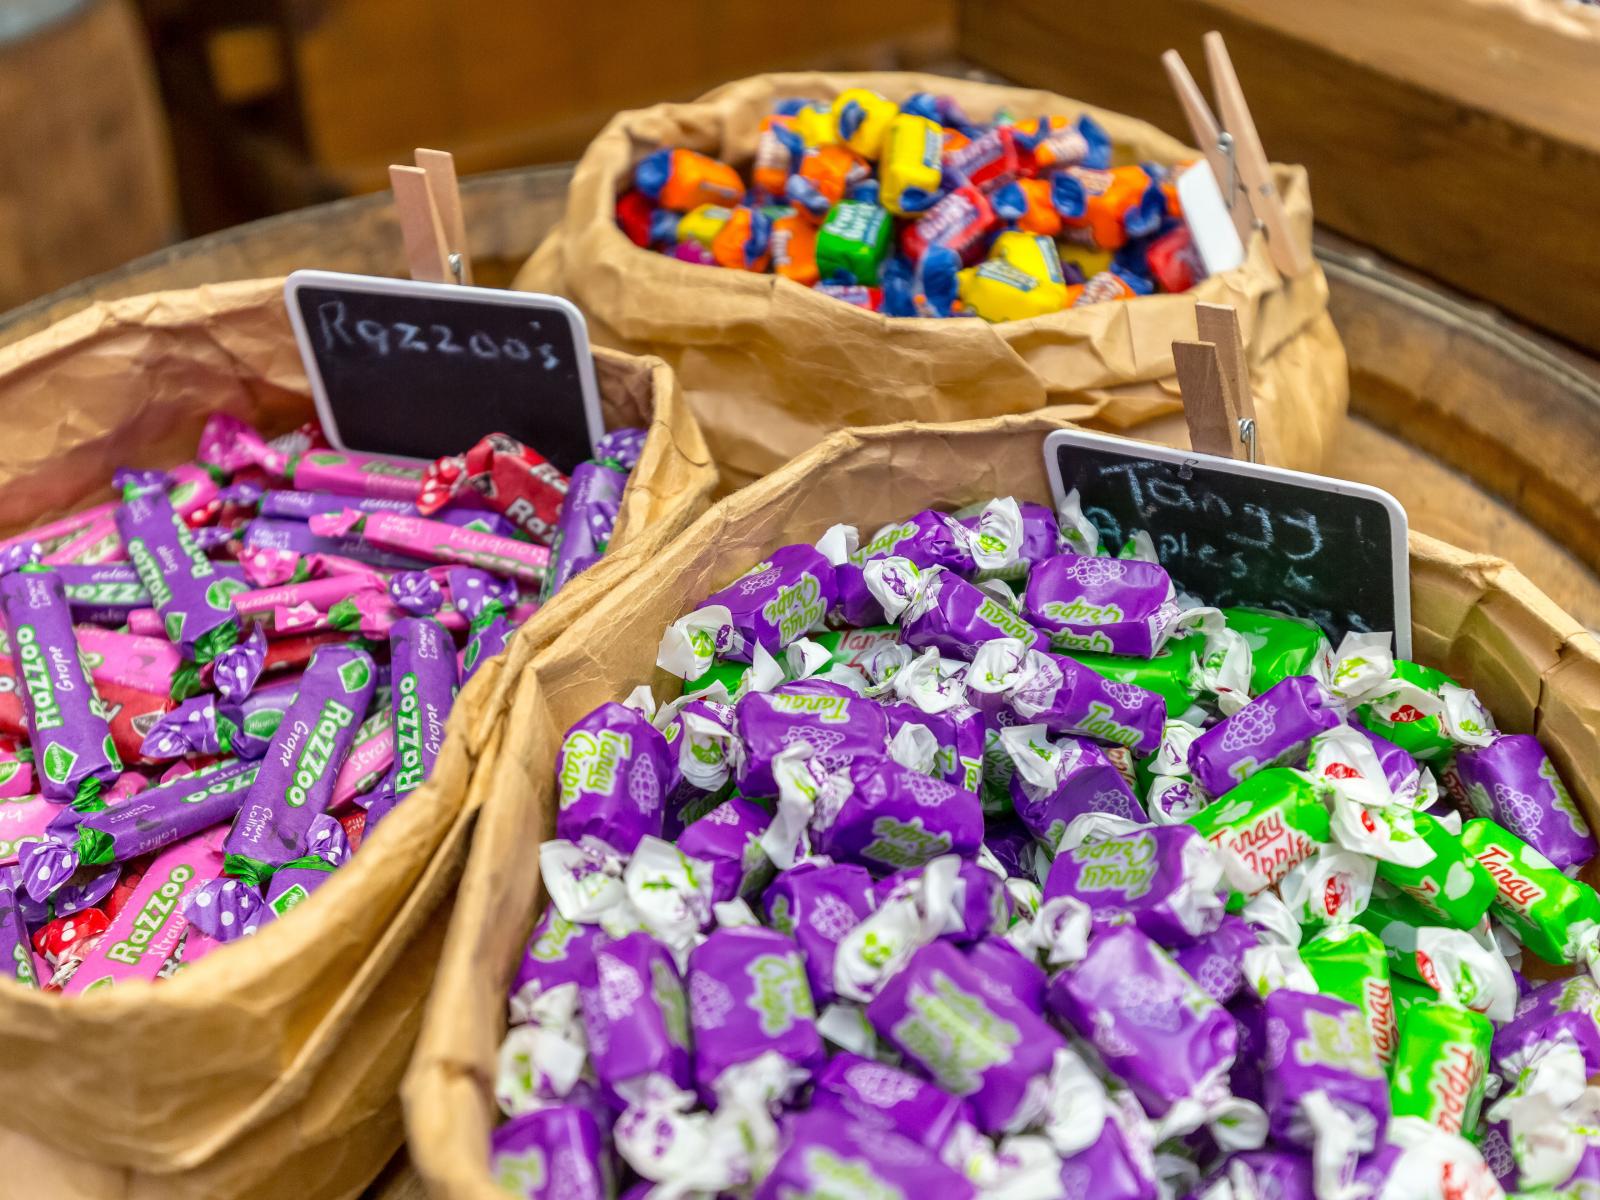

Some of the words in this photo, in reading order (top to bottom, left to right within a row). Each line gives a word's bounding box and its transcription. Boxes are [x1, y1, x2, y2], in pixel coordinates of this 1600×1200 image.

[1100, 461, 1324, 561] Tangy
[1085, 506, 1248, 578] Aples
[764, 576, 820, 622] Grape
[1046, 598, 1122, 624] Grape
[1050, 630, 1113, 652] Grap
[278, 719, 310, 768] Grape
[562, 733, 597, 806] Grape
[586, 731, 630, 793] Tangy
[1476, 846, 1542, 904] Tangy
